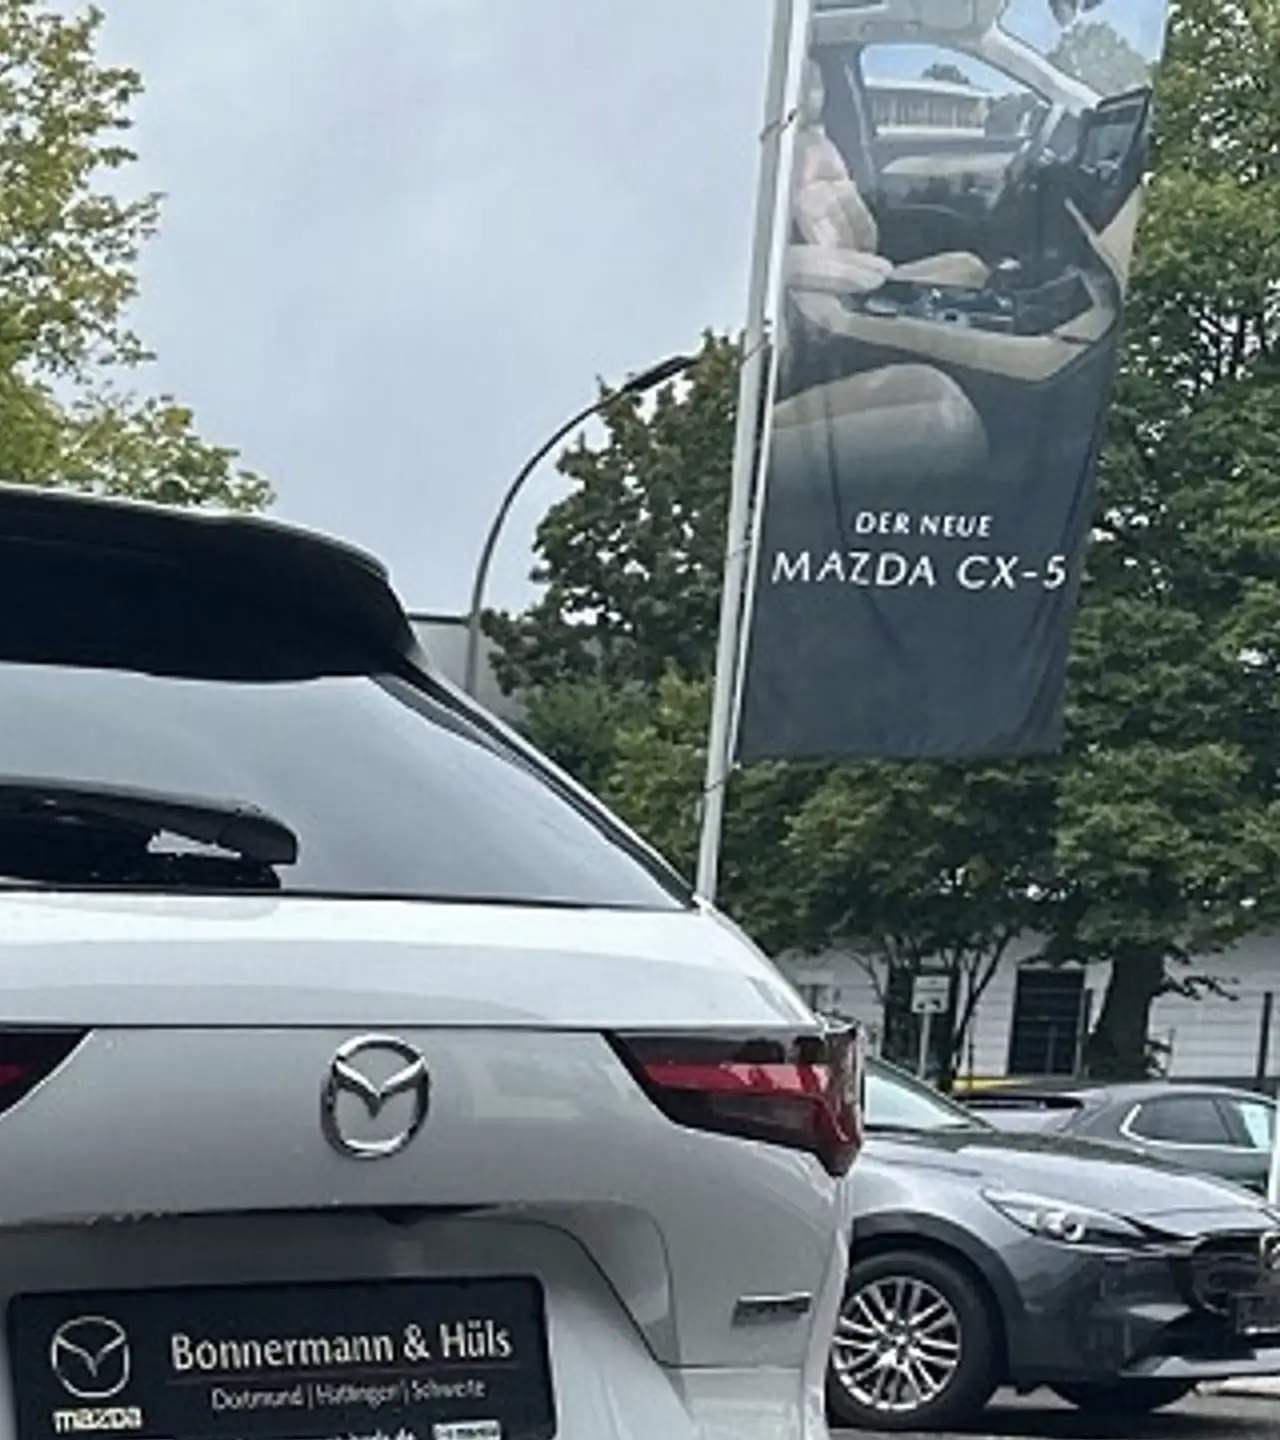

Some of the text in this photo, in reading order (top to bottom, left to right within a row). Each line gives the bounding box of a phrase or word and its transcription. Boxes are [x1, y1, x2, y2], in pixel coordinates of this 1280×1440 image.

[854, 510, 994, 539] DER NEUE
[770, 550, 1067, 590] MAZDA CX-5
[170, 1320, 513, 1371] Bonnermann & Hüls
